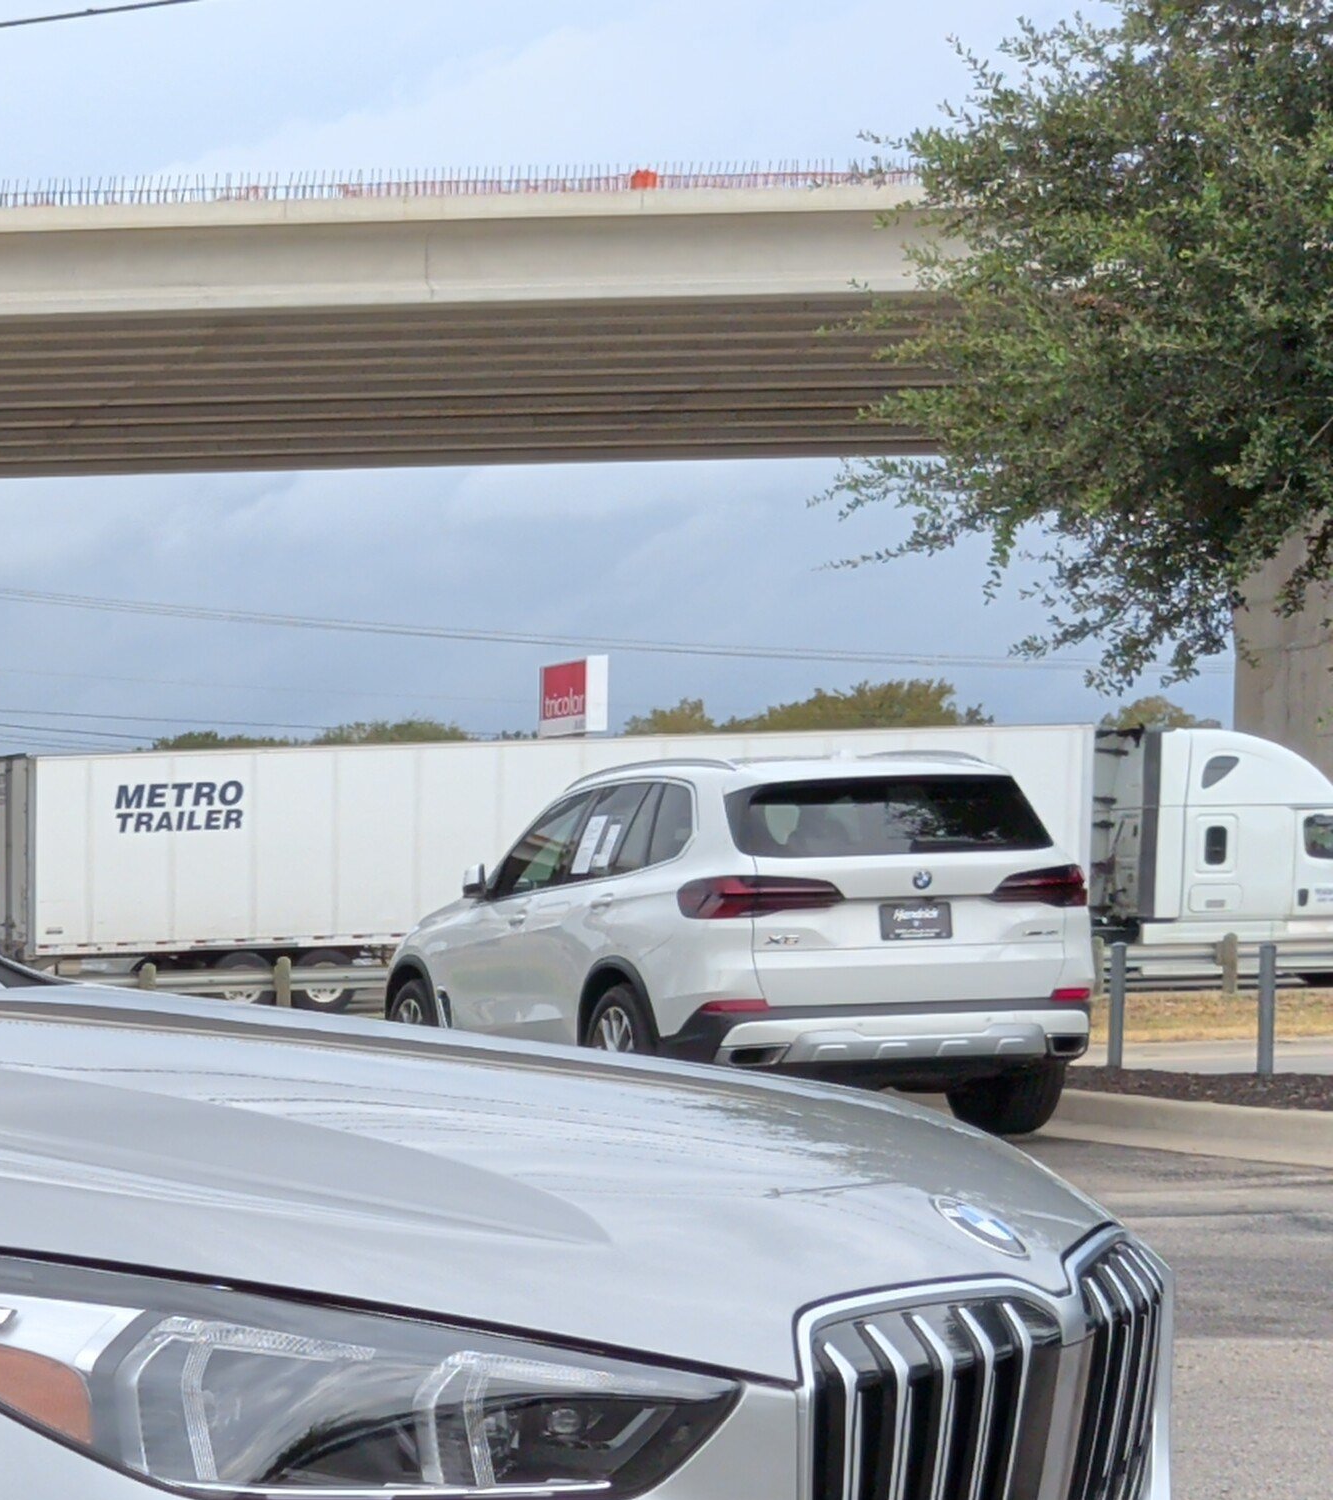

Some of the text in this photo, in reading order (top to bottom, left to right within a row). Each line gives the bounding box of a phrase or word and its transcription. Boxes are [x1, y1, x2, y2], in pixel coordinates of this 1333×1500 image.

[544, 687, 585, 717] tricolor
[114, 780, 244, 809] METRO
[116, 809, 243, 833] TRAILER
